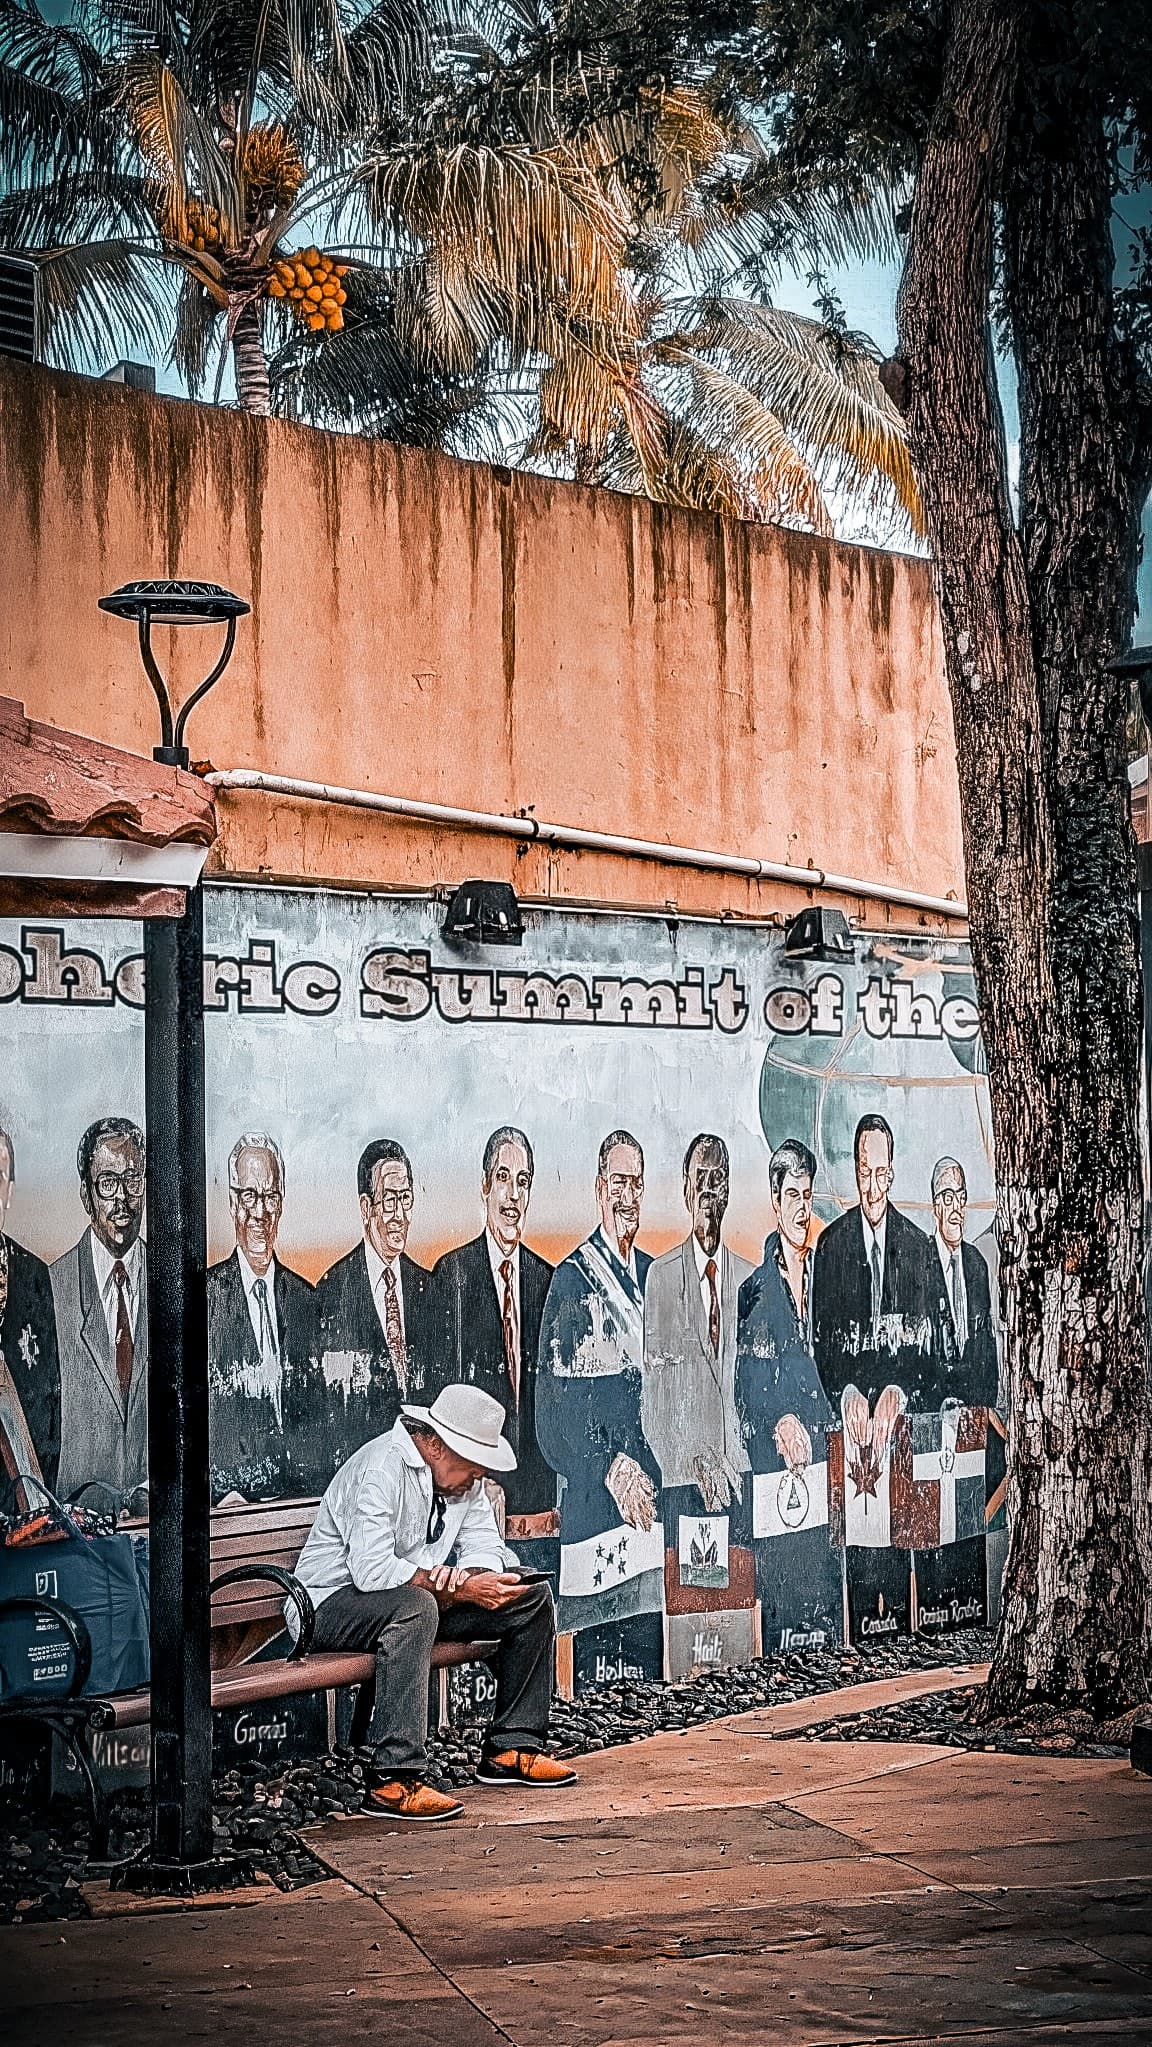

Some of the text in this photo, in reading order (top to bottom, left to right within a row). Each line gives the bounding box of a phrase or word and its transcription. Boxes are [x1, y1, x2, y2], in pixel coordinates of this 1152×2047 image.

[361, 947, 748, 1035] Summit
[763, 972, 843, 1036] of
[857, 975, 981, 1040] the
[692, 1632, 723, 1664] Haiti
